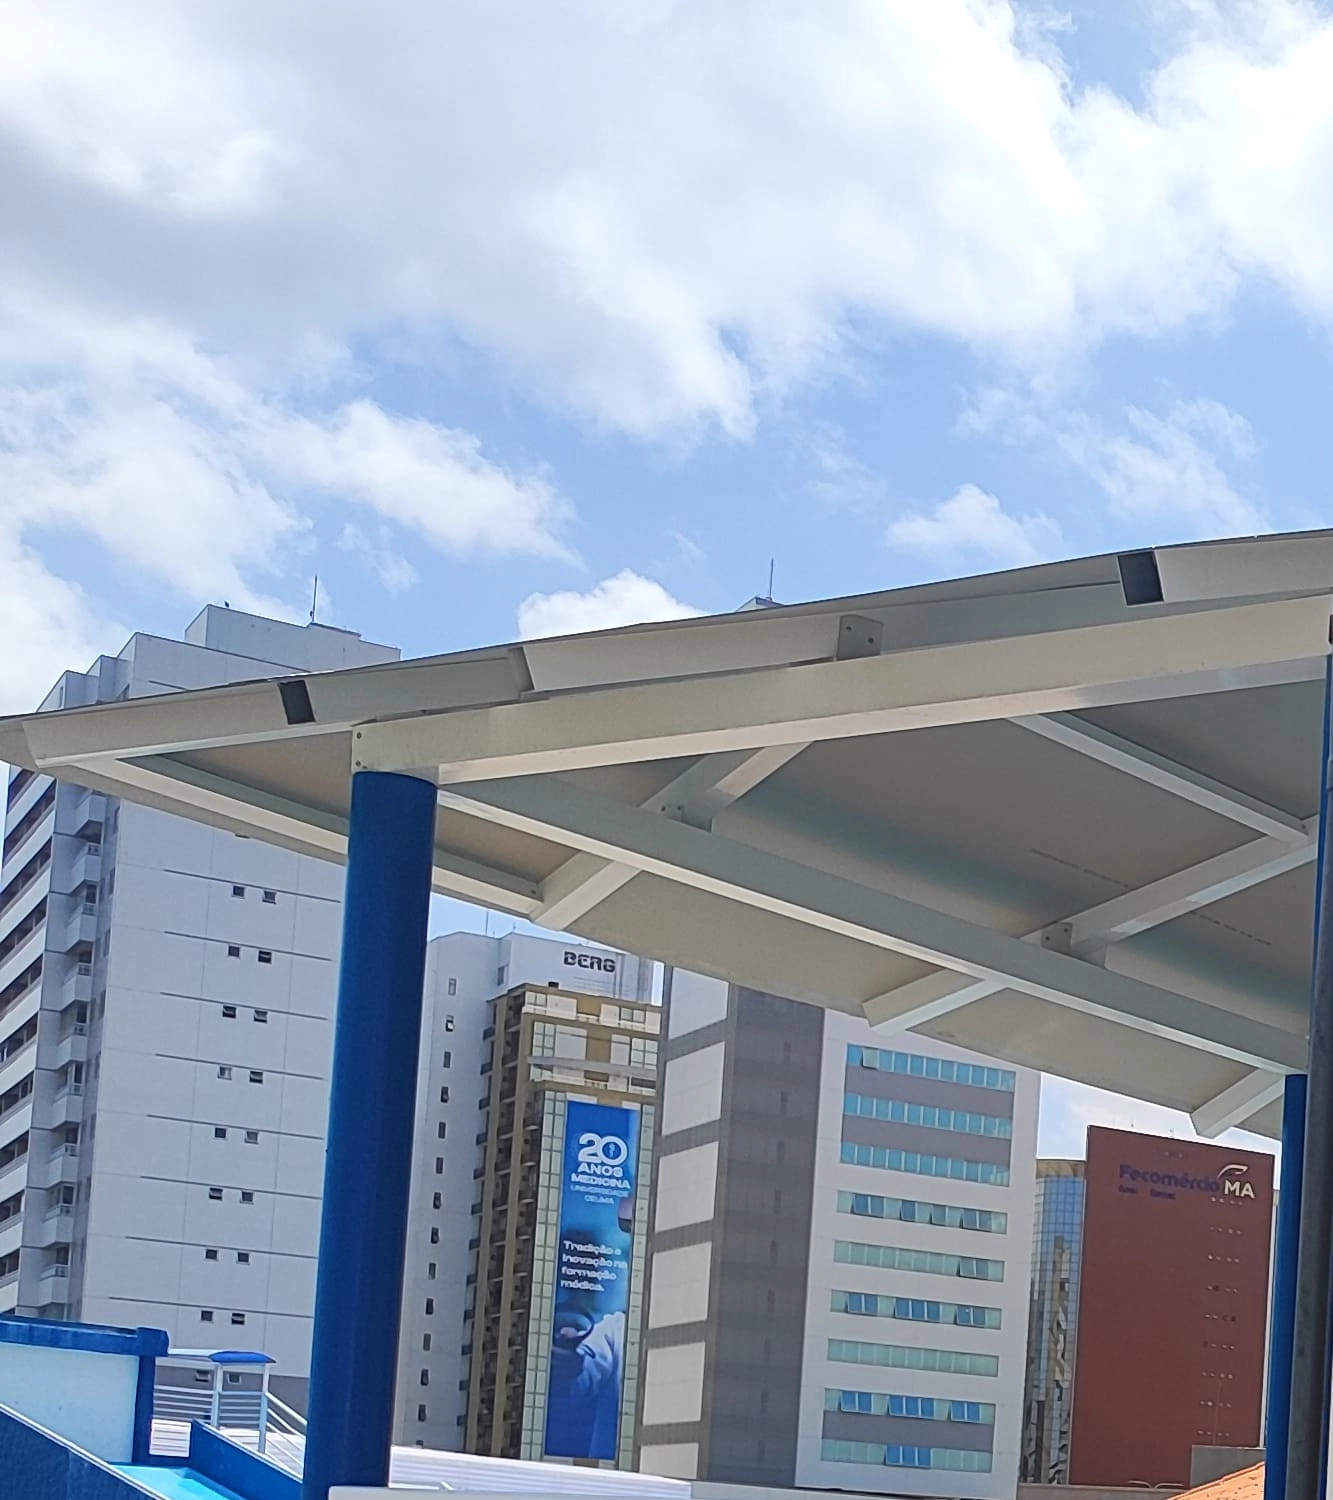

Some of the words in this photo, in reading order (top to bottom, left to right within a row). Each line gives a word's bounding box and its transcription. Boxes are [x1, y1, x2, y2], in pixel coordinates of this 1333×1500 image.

[563, 951, 616, 973] BERG
[578, 1132, 628, 1166] 20
[577, 1162, 624, 1178] ANOS
[571, 1173, 632, 1189] MEDICINA
[1224, 1179, 1256, 1199] MA
[561, 1266, 617, 1280] formação
